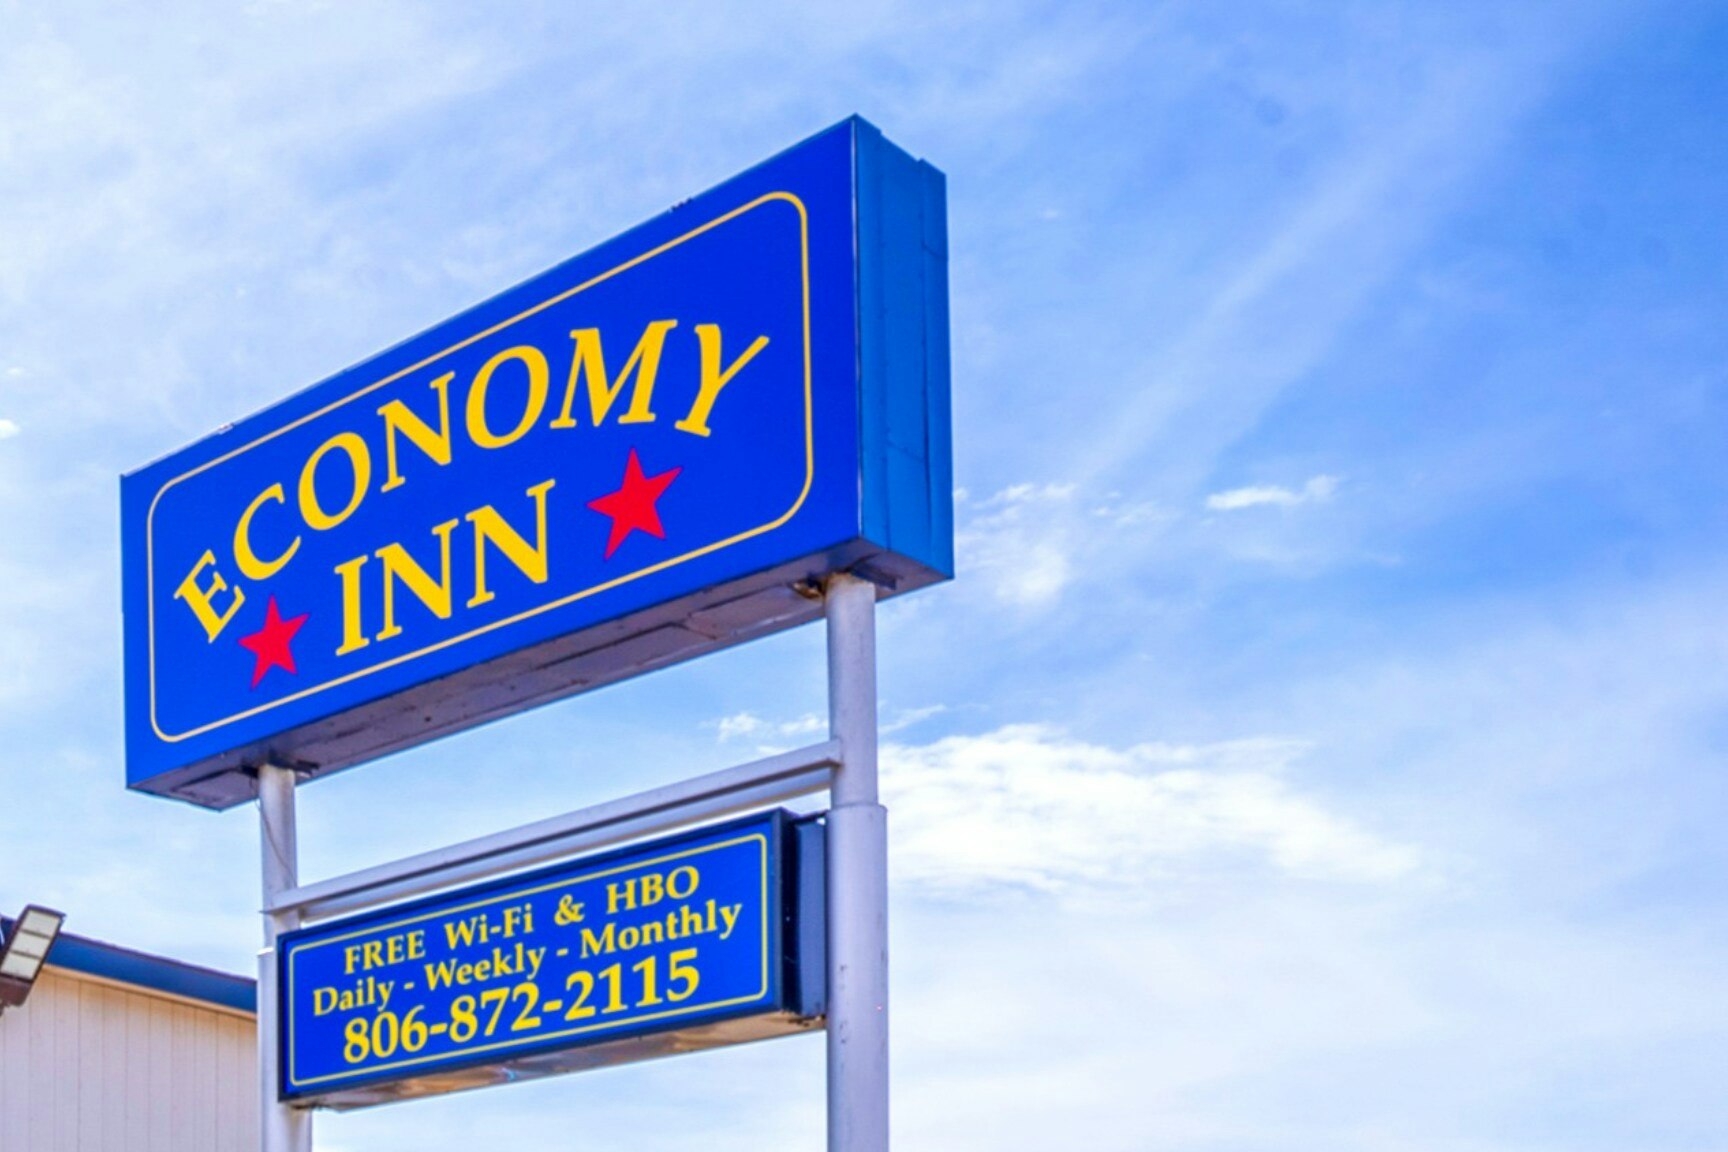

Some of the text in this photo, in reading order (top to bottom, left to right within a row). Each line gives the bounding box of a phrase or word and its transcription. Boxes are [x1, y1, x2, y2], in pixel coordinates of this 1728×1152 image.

[173, 318, 770, 644] ECONOMY
[334, 479, 557, 656] INN
[313, 976, 394, 1017] Daily
[424, 942, 547, 992] Weekly
[580, 899, 743, 960] Monthly
[344, 865, 700, 975] FREE Wi-Fi & HBO
[343, 947, 700, 1064] 806-872-2115
